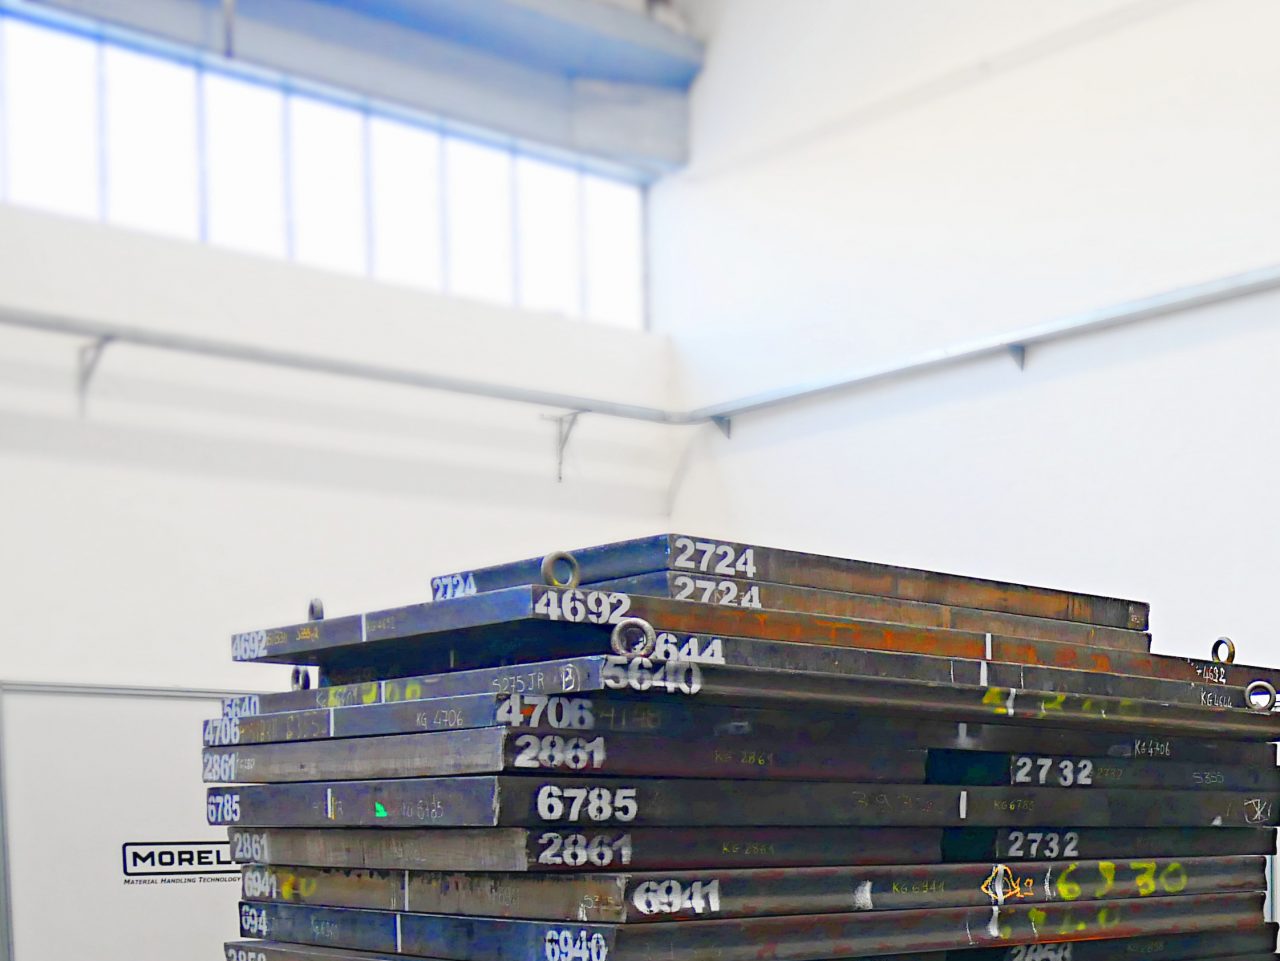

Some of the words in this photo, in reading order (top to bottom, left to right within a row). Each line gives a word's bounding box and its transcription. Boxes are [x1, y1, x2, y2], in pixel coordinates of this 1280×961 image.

[674, 538, 756, 577] 2724
[433, 573, 476, 600] 2724
[674, 575, 762, 609] 2724
[535, 591, 631, 624] 4692
[233, 630, 268, 658] 4692
[603, 655, 701, 694] 5640
[223, 694, 259, 717] 5640
[497, 694, 595, 729] 4706
[204, 717, 240, 745] 4706
[514, 734, 606, 769] 2861
[204, 753, 237, 780] 2861
[1015, 757, 1093, 786] 2732
[207, 794, 241, 822] 6785
[537, 785, 637, 821] 6785
[132, 849, 250, 866] MOREL
[234, 832, 269, 860] 2861
[538, 832, 632, 866] 2861
[1008, 832, 1079, 858] 2732
[245, 871, 277, 899] 6941
[633, 879, 720, 914] 6941
